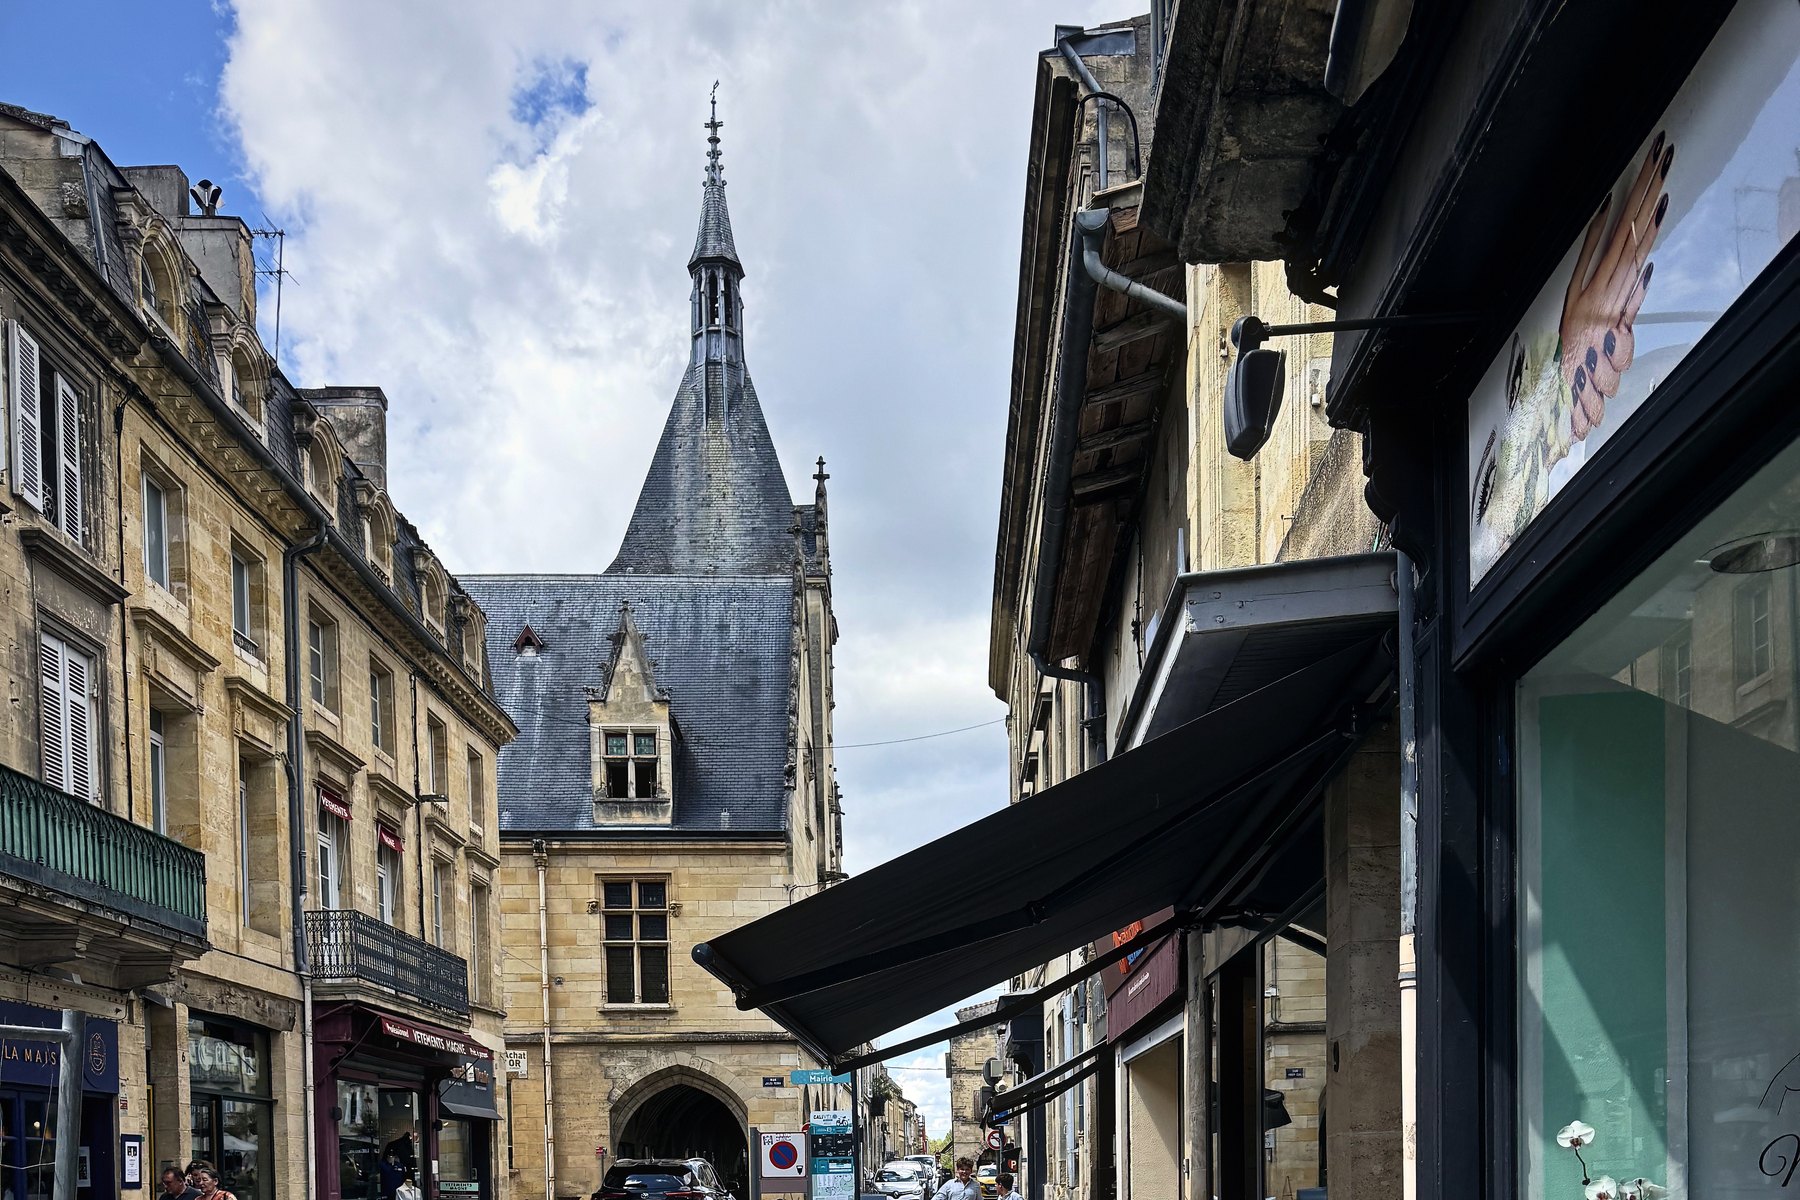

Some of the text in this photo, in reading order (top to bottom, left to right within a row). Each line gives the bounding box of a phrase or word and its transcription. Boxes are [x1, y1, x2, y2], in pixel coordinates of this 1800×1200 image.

[321, 795, 348, 817] VETEMENTS
[412, 1029, 445, 1050] VETEMENTS
[445, 1039, 467, 1055] MAGNE
[4, 1045, 57, 1065] LA MAIS
[181, 1051, 186, 1063] 6
[1010, 1160, 1017, 1169] P
